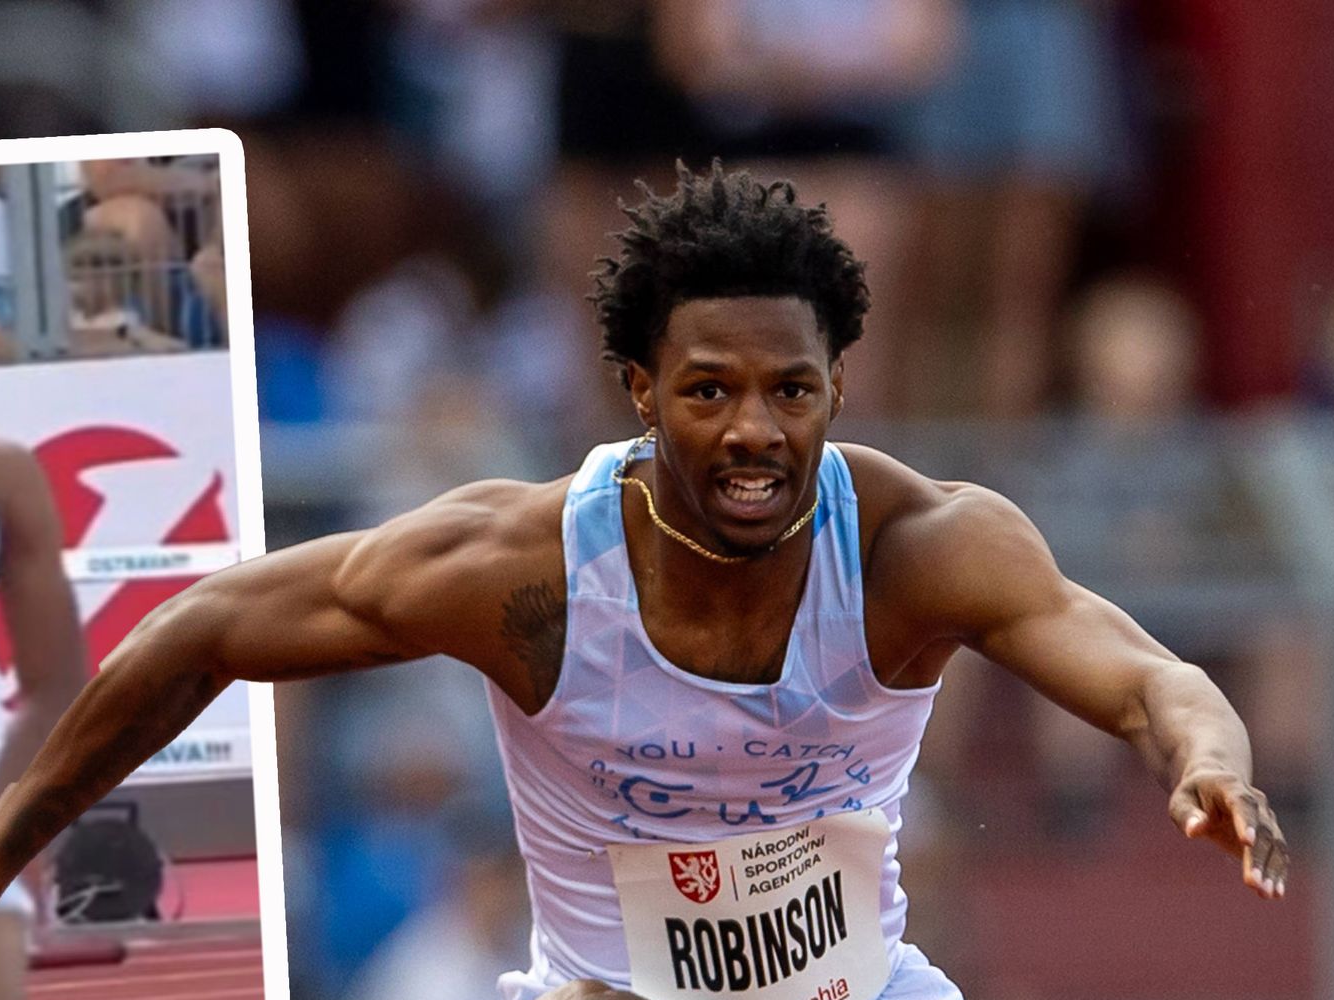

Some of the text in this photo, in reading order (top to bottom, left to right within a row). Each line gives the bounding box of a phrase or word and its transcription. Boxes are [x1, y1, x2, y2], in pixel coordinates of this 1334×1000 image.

[149, 742, 232, 765] AVA!!!
[616, 739, 855, 761] YOU CATCH
[741, 826, 811, 861] NÁRODNÍ
[744, 834, 826, 879] SPORTOVNÍ
[748, 853, 822, 896] AGENTURA
[665, 870, 848, 993] ROBINSON
